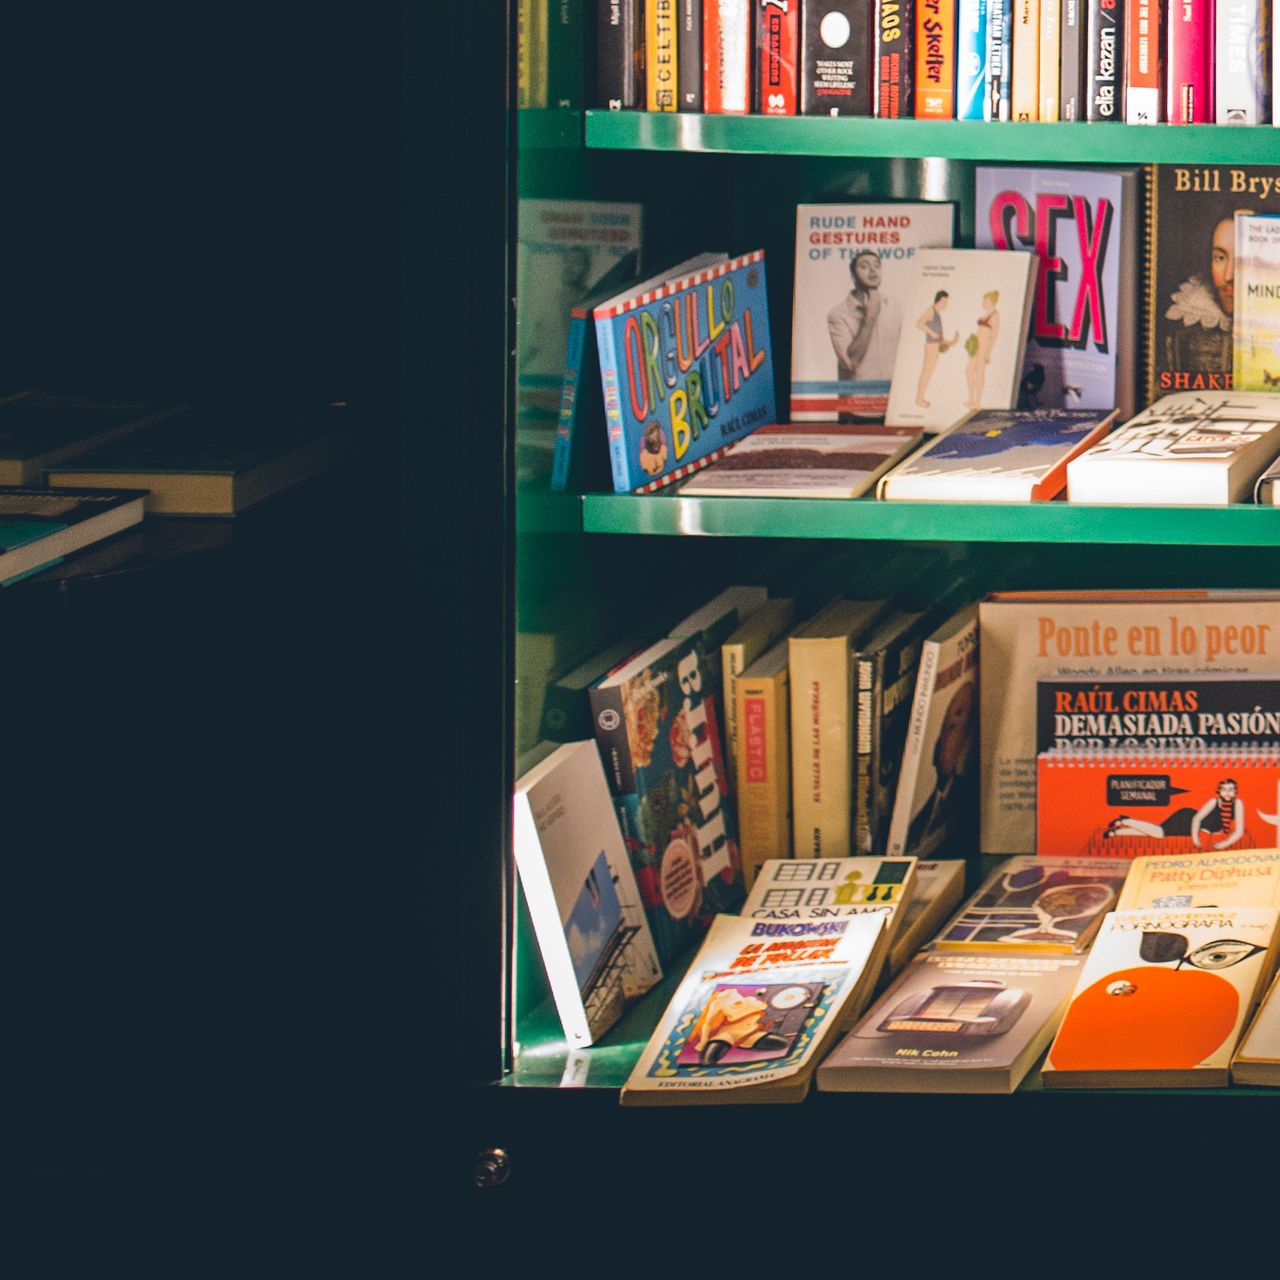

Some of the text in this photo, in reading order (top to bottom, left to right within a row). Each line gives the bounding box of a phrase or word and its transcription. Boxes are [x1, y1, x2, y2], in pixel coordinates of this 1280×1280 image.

[1228, 5, 1246, 72] TIMES
[923, 19, 945, 84] Skelter
[1098, 28, 1116, 81] kazan
[1098, 85, 1115, 116] elia
[1175, 169, 1220, 193] Bill
[810, 216, 911, 229] RUDE HAND
[809, 231, 900, 244] GESTURES
[809, 247, 831, 261] OF
[838, 248, 871, 261] TH
[989, 190, 1113, 354] SEX
[624, 280, 765, 460] ORGULLO BRUTAL
[1038, 617, 1271, 662] Ponte en lo peor
[1055, 685, 1198, 713] RAÚL CIMAS
[1055, 713, 1194, 737] DEMASIADA
[1150, 865, 1272, 883] Patty Diphusa
[752, 908, 800, 919] CASA
[808, 907, 840, 919] SIN
[751, 920, 849, 937] BUKOWSKI
[896, 1048, 958, 1058] Nik Cohn
[658, 1073, 776, 1089] EDITORIAL ANAGRAMA
